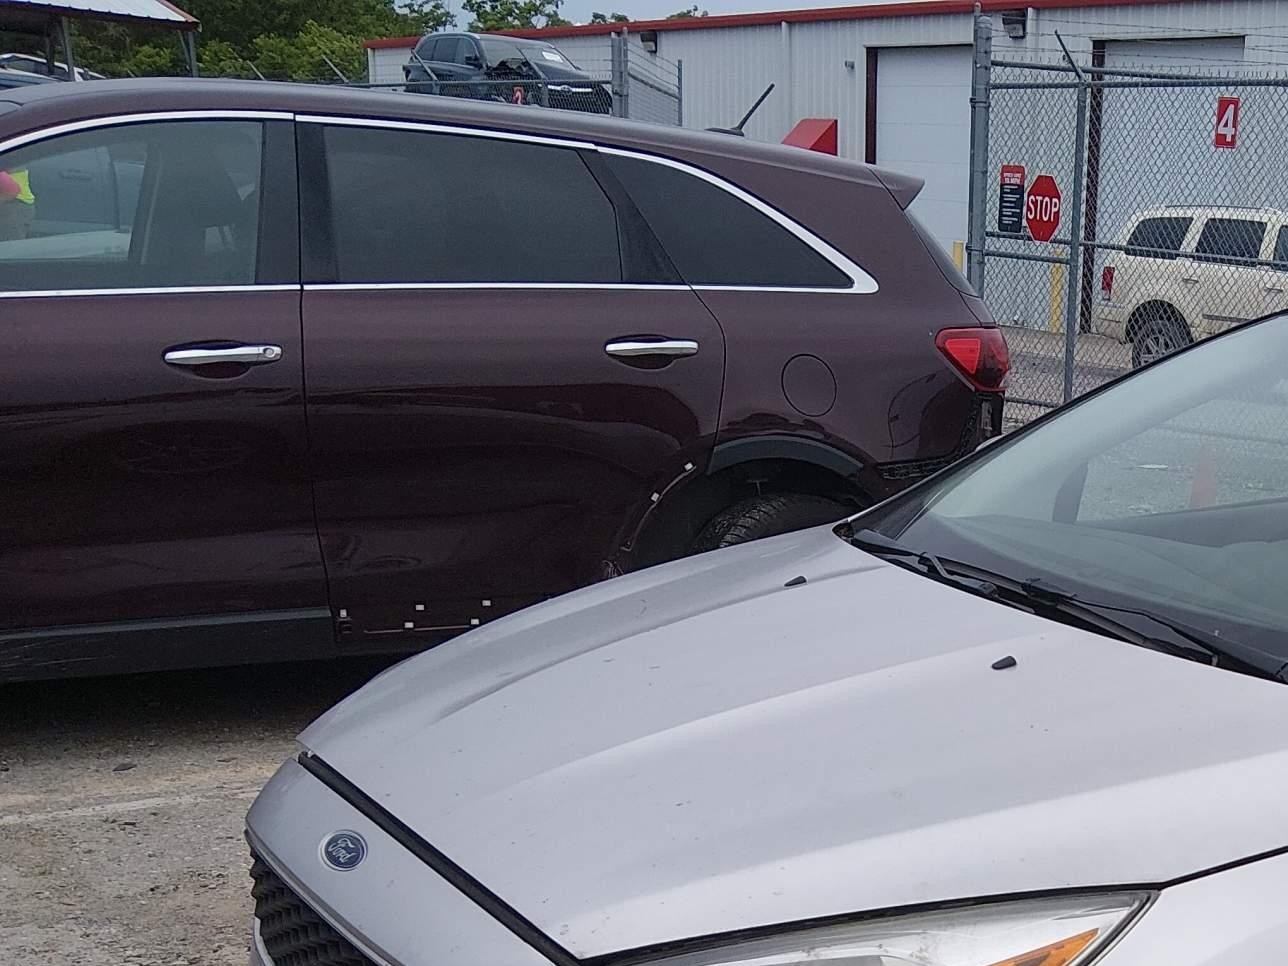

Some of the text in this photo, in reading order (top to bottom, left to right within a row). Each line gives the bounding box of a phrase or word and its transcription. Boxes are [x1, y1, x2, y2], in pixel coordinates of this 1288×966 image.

[1218, 104, 1235, 142] 4
[1027, 195, 1060, 222] STOP
[327, 837, 357, 863] Ford
